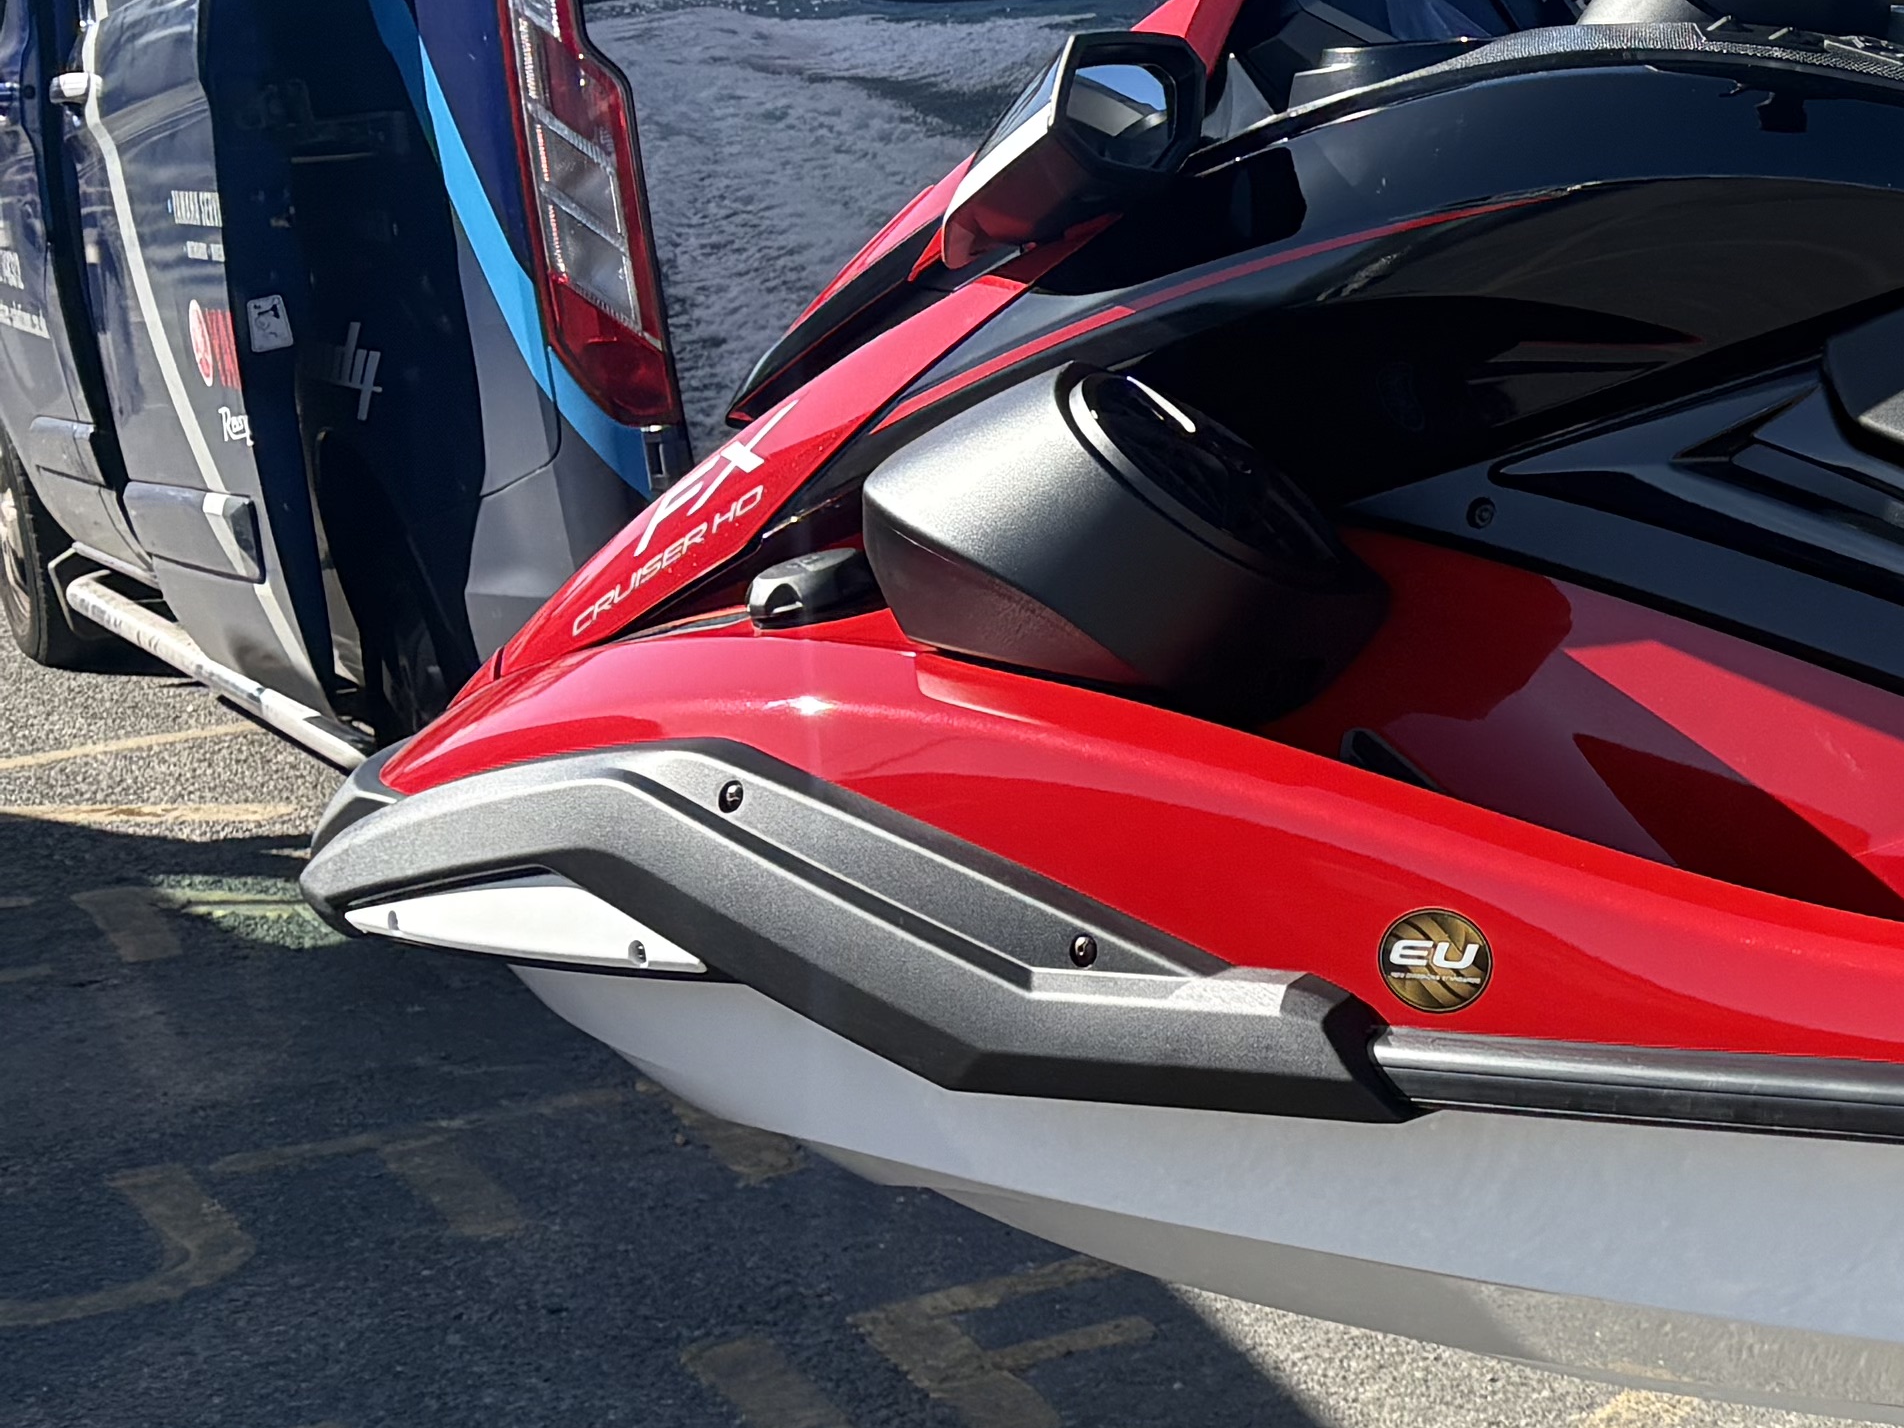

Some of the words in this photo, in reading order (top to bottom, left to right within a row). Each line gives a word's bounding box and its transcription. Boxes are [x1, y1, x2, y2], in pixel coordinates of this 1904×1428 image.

[633, 392, 803, 558] FX
[572, 521, 708, 637] CRUISER
[712, 484, 764, 534] HO
[1389, 939, 1480, 970] EU
